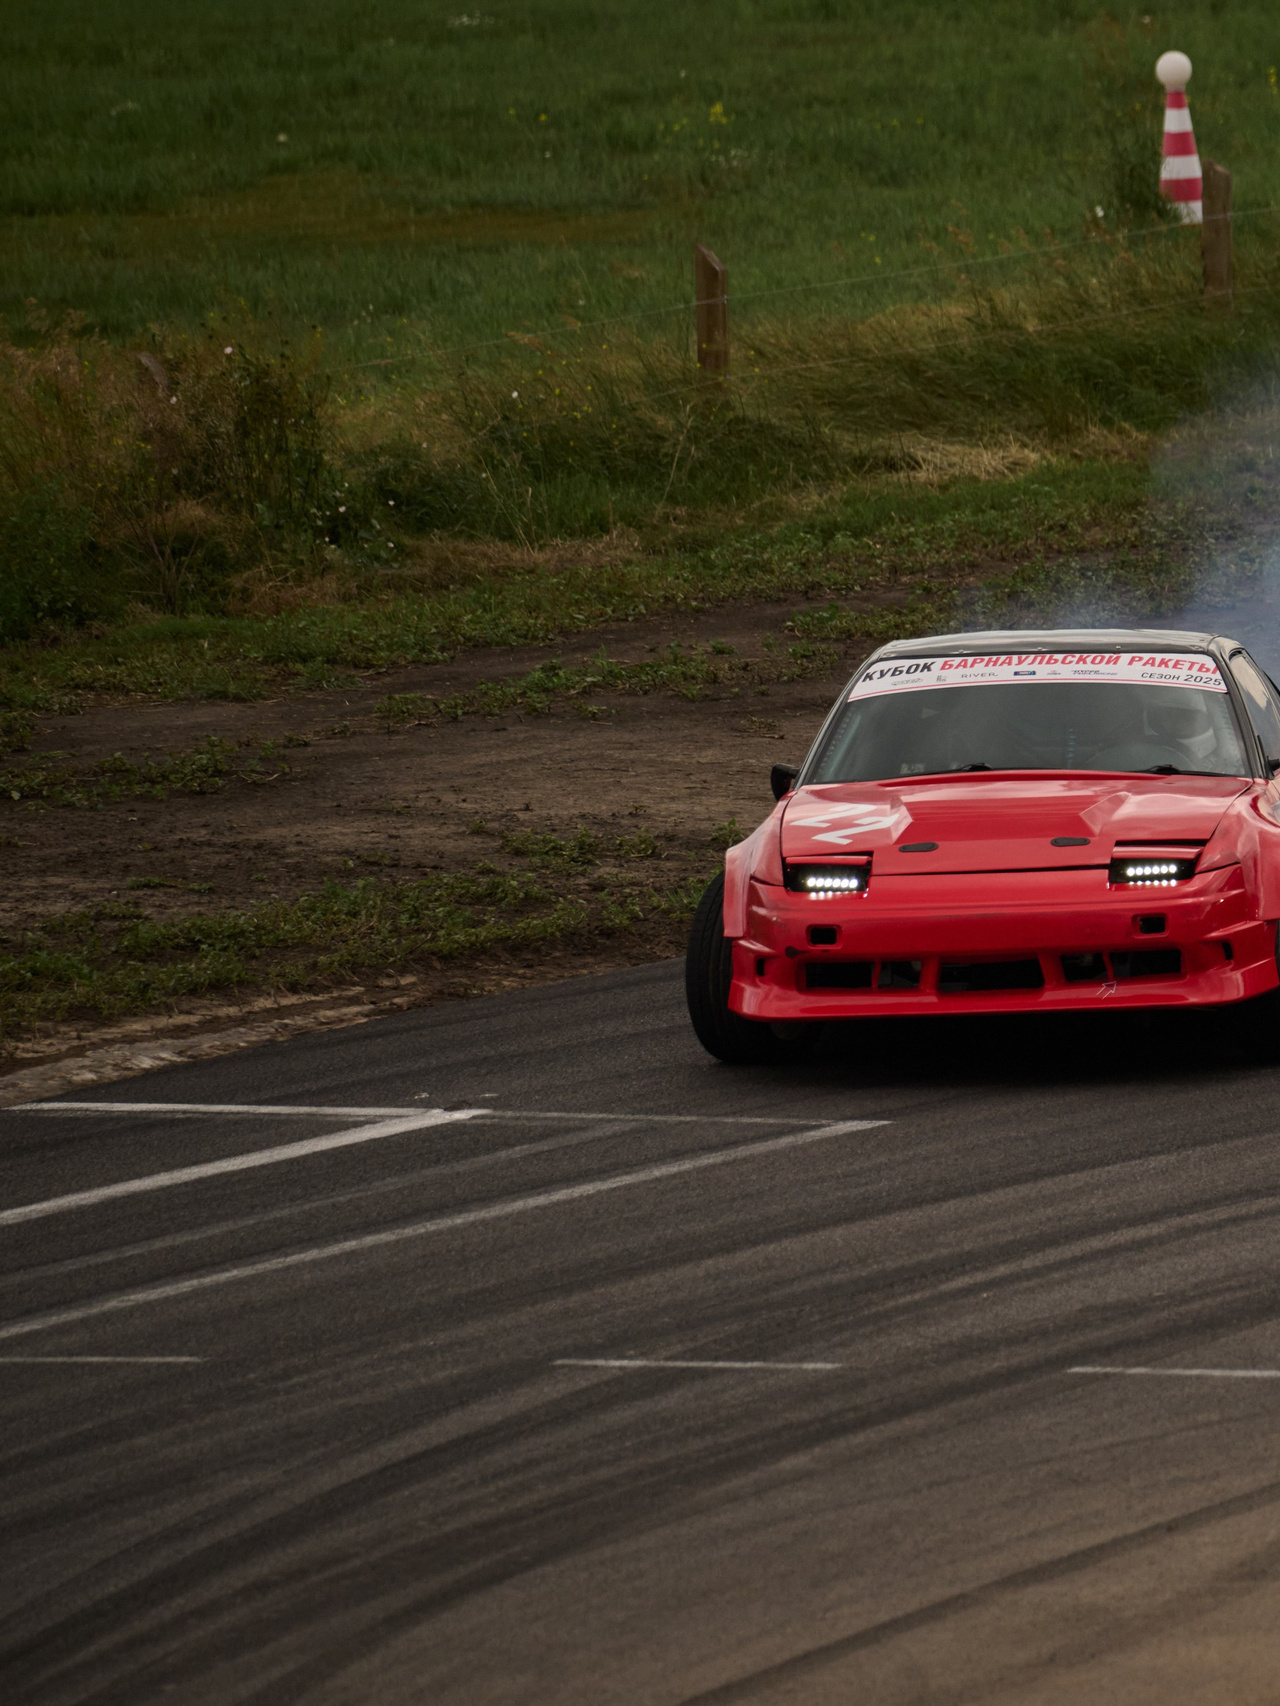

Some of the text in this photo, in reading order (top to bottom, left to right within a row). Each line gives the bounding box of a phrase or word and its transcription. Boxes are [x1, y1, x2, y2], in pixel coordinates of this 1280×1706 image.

[861, 661, 936, 683] КУБОК
[939, 653, 1121, 671] БАРНАУЛЬСКОЙ
[1127, 655, 1220, 675] РАКЕТЫ
[1141, 672, 1223, 686] СЕЗОН 2025
[789, 803, 900, 845] 22
